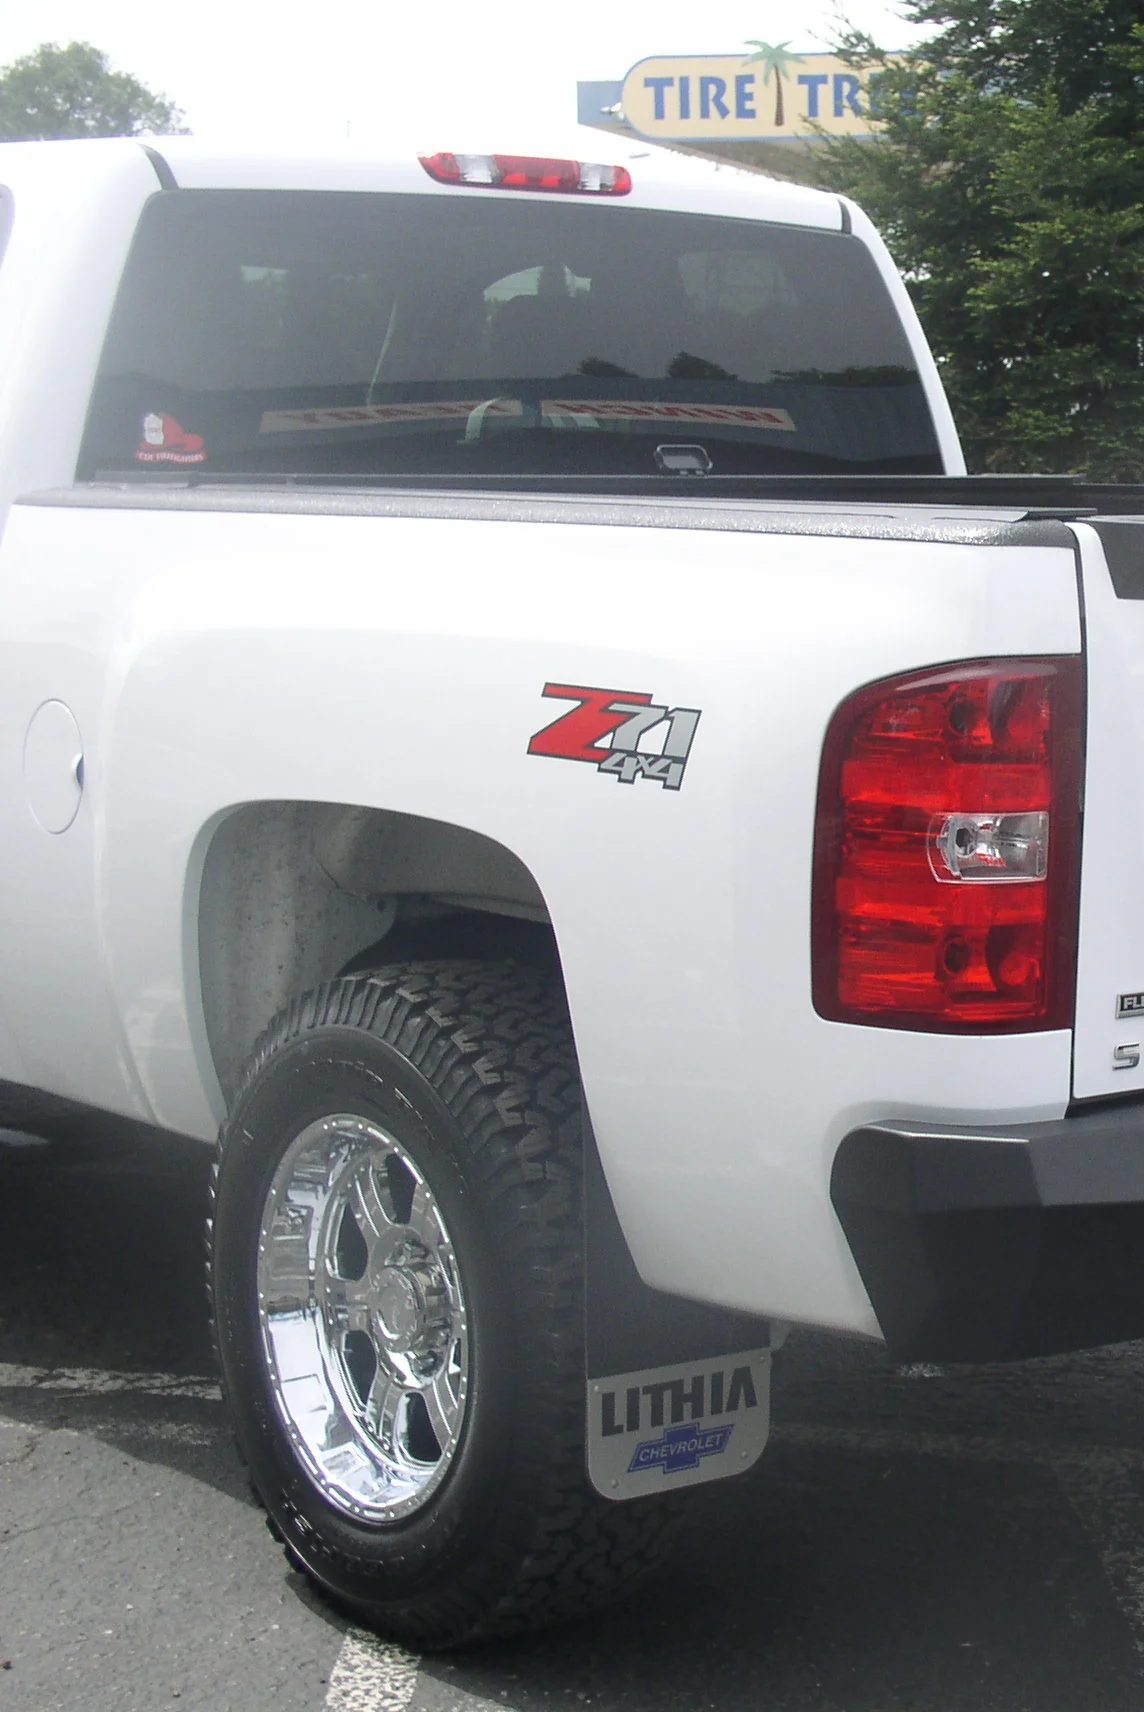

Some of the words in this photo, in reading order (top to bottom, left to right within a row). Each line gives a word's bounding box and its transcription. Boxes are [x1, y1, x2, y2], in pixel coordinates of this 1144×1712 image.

[643, 73, 757, 120] TIRE
[797, 72, 919, 118] TR
[527, 682, 702, 766] Z71
[601, 1366, 758, 1437] LITHIA
[638, 1433, 724, 1462] CHEVROLET
